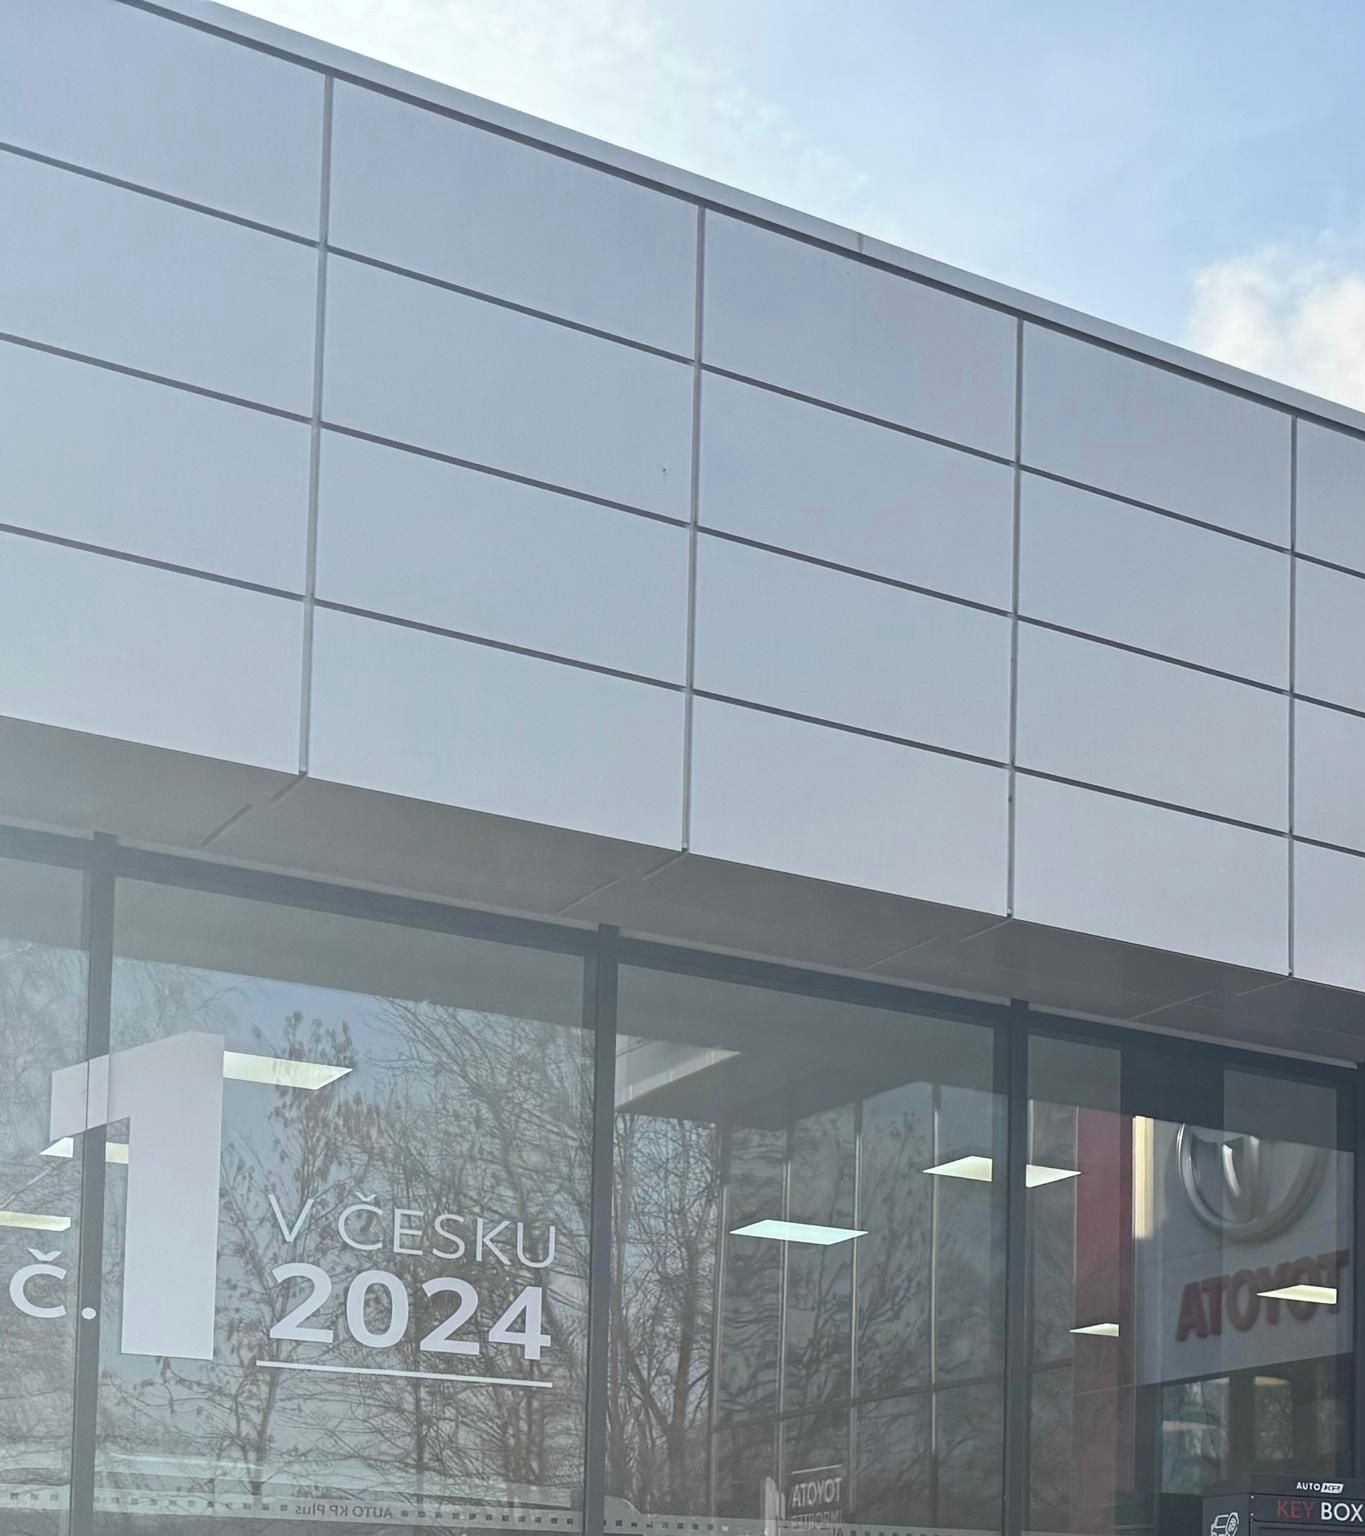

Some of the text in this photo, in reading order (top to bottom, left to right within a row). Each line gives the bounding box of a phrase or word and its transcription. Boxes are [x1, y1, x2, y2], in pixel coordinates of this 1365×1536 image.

[50, 1031, 224, 1360] 1
[268, 1191, 557, 1268] V ČESKU
[269, 1263, 551, 1361] 2024
[1278, 1499, 1363, 1522] KEY BOX
[1296, 1482, 1321, 1491] AUTO
